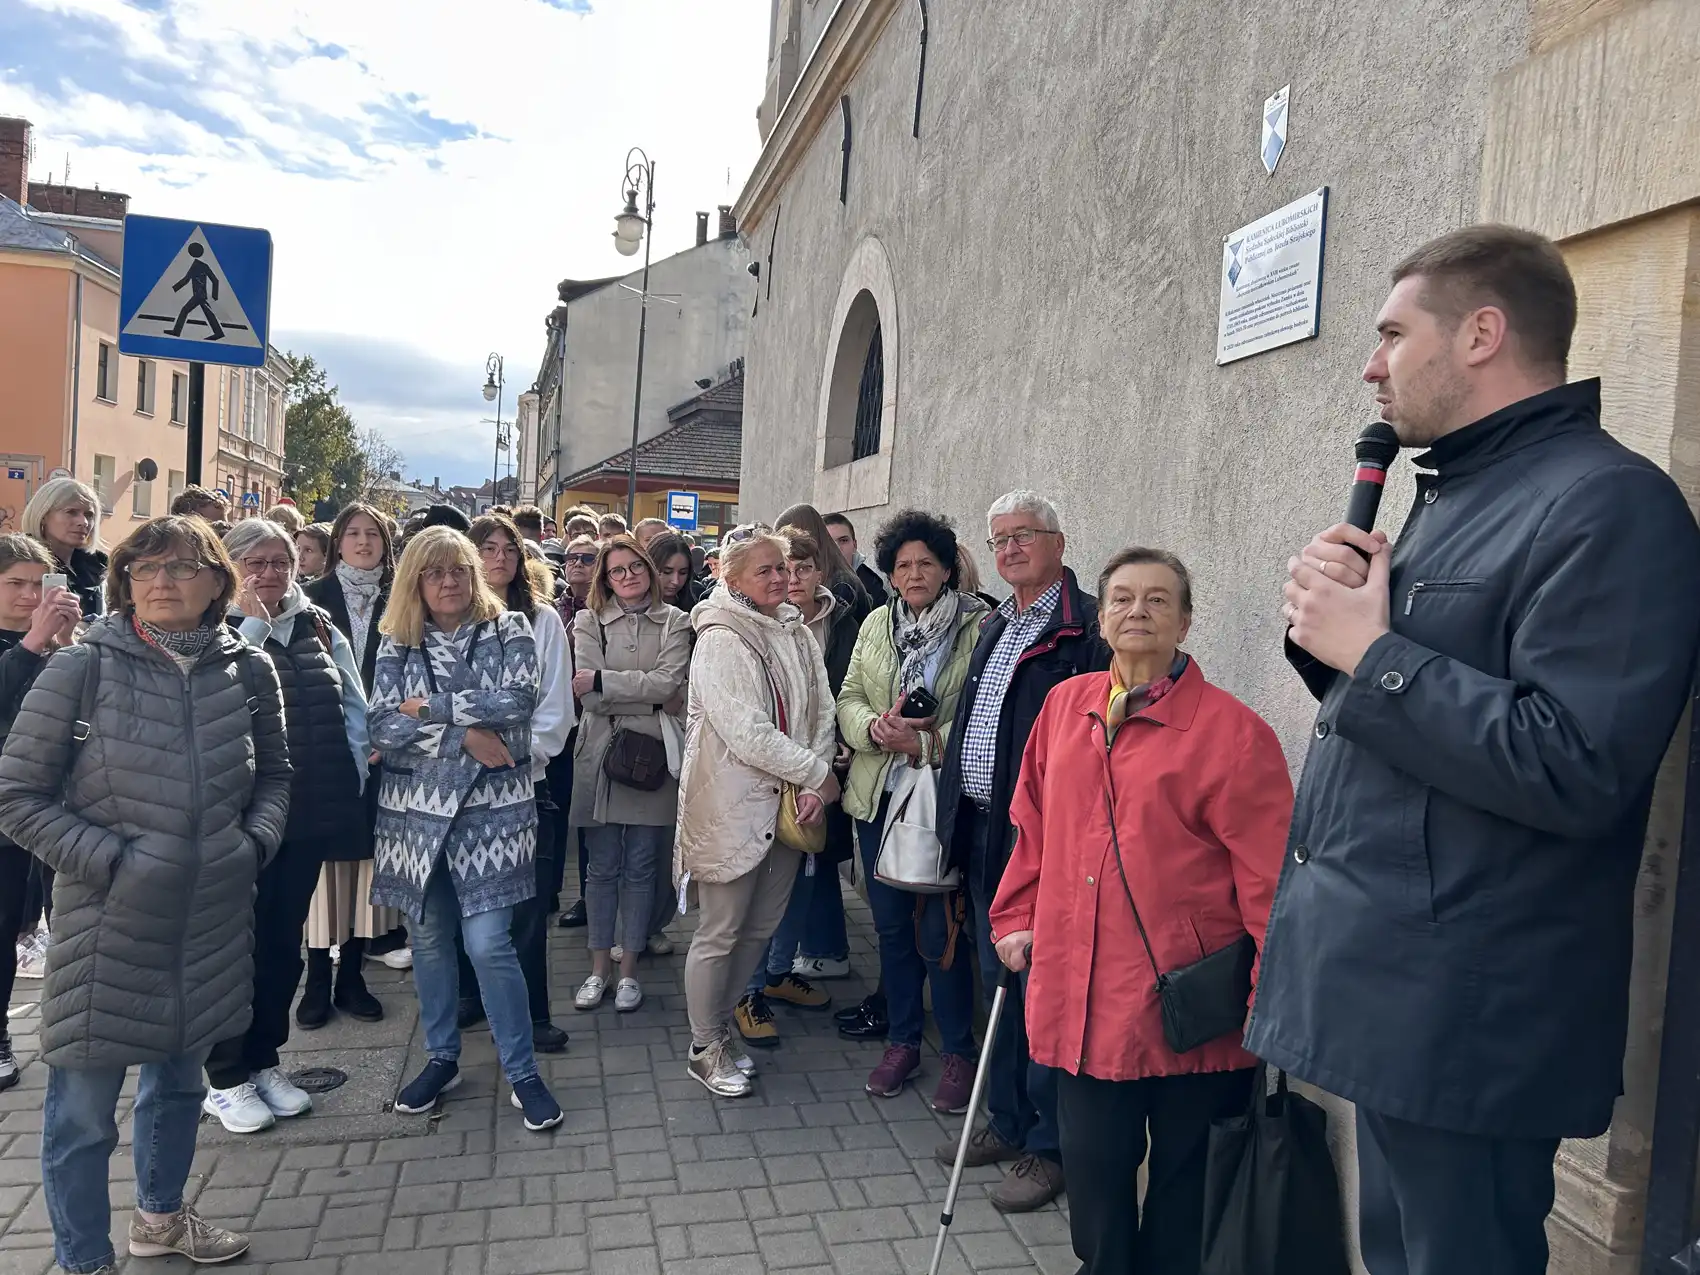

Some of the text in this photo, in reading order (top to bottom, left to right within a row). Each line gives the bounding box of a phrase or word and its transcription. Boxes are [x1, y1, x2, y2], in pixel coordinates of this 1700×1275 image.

[1246, 202, 1319, 242] KAMIENICA LUBOMIRSKICH
[1285, 218, 1309, 235] Biblioteki
